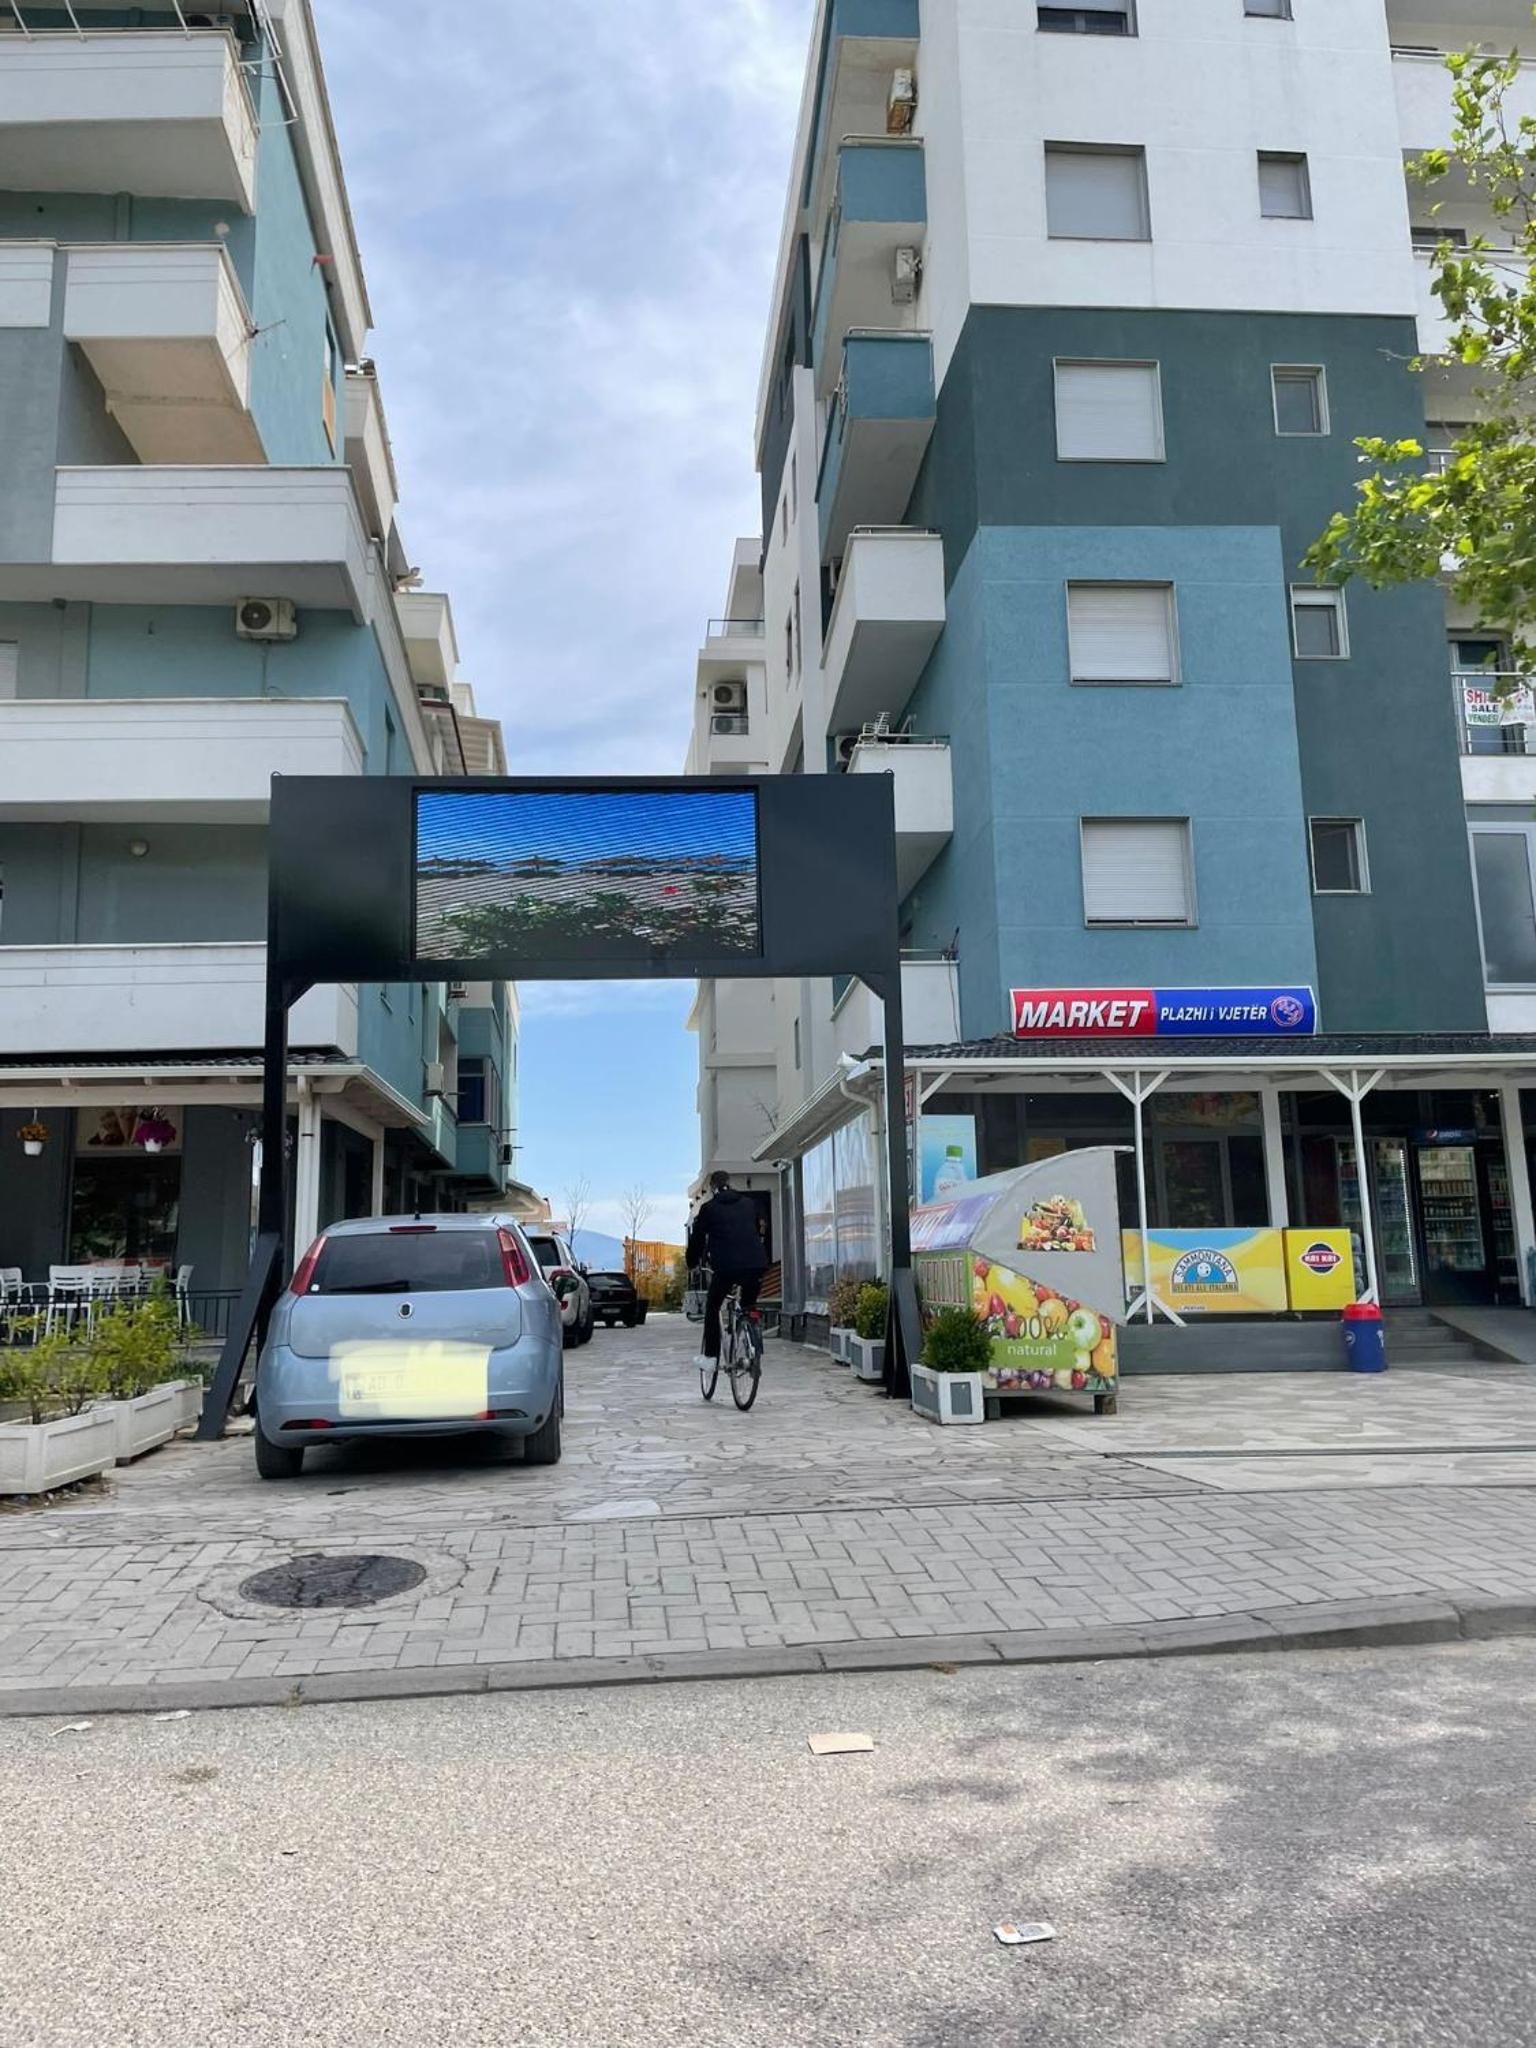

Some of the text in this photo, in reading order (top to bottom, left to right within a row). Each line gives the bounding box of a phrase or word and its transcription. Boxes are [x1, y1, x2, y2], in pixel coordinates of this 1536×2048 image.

[1018, 1000, 1149, 1028] MARKET
[1160, 1006, 1208, 1021] PLAZHI
[1218, 1004, 1268, 1021] VJETËR
[1174, 1250, 1233, 1278] SAMMONTANA
[1007, 1344, 1057, 1356] natural
